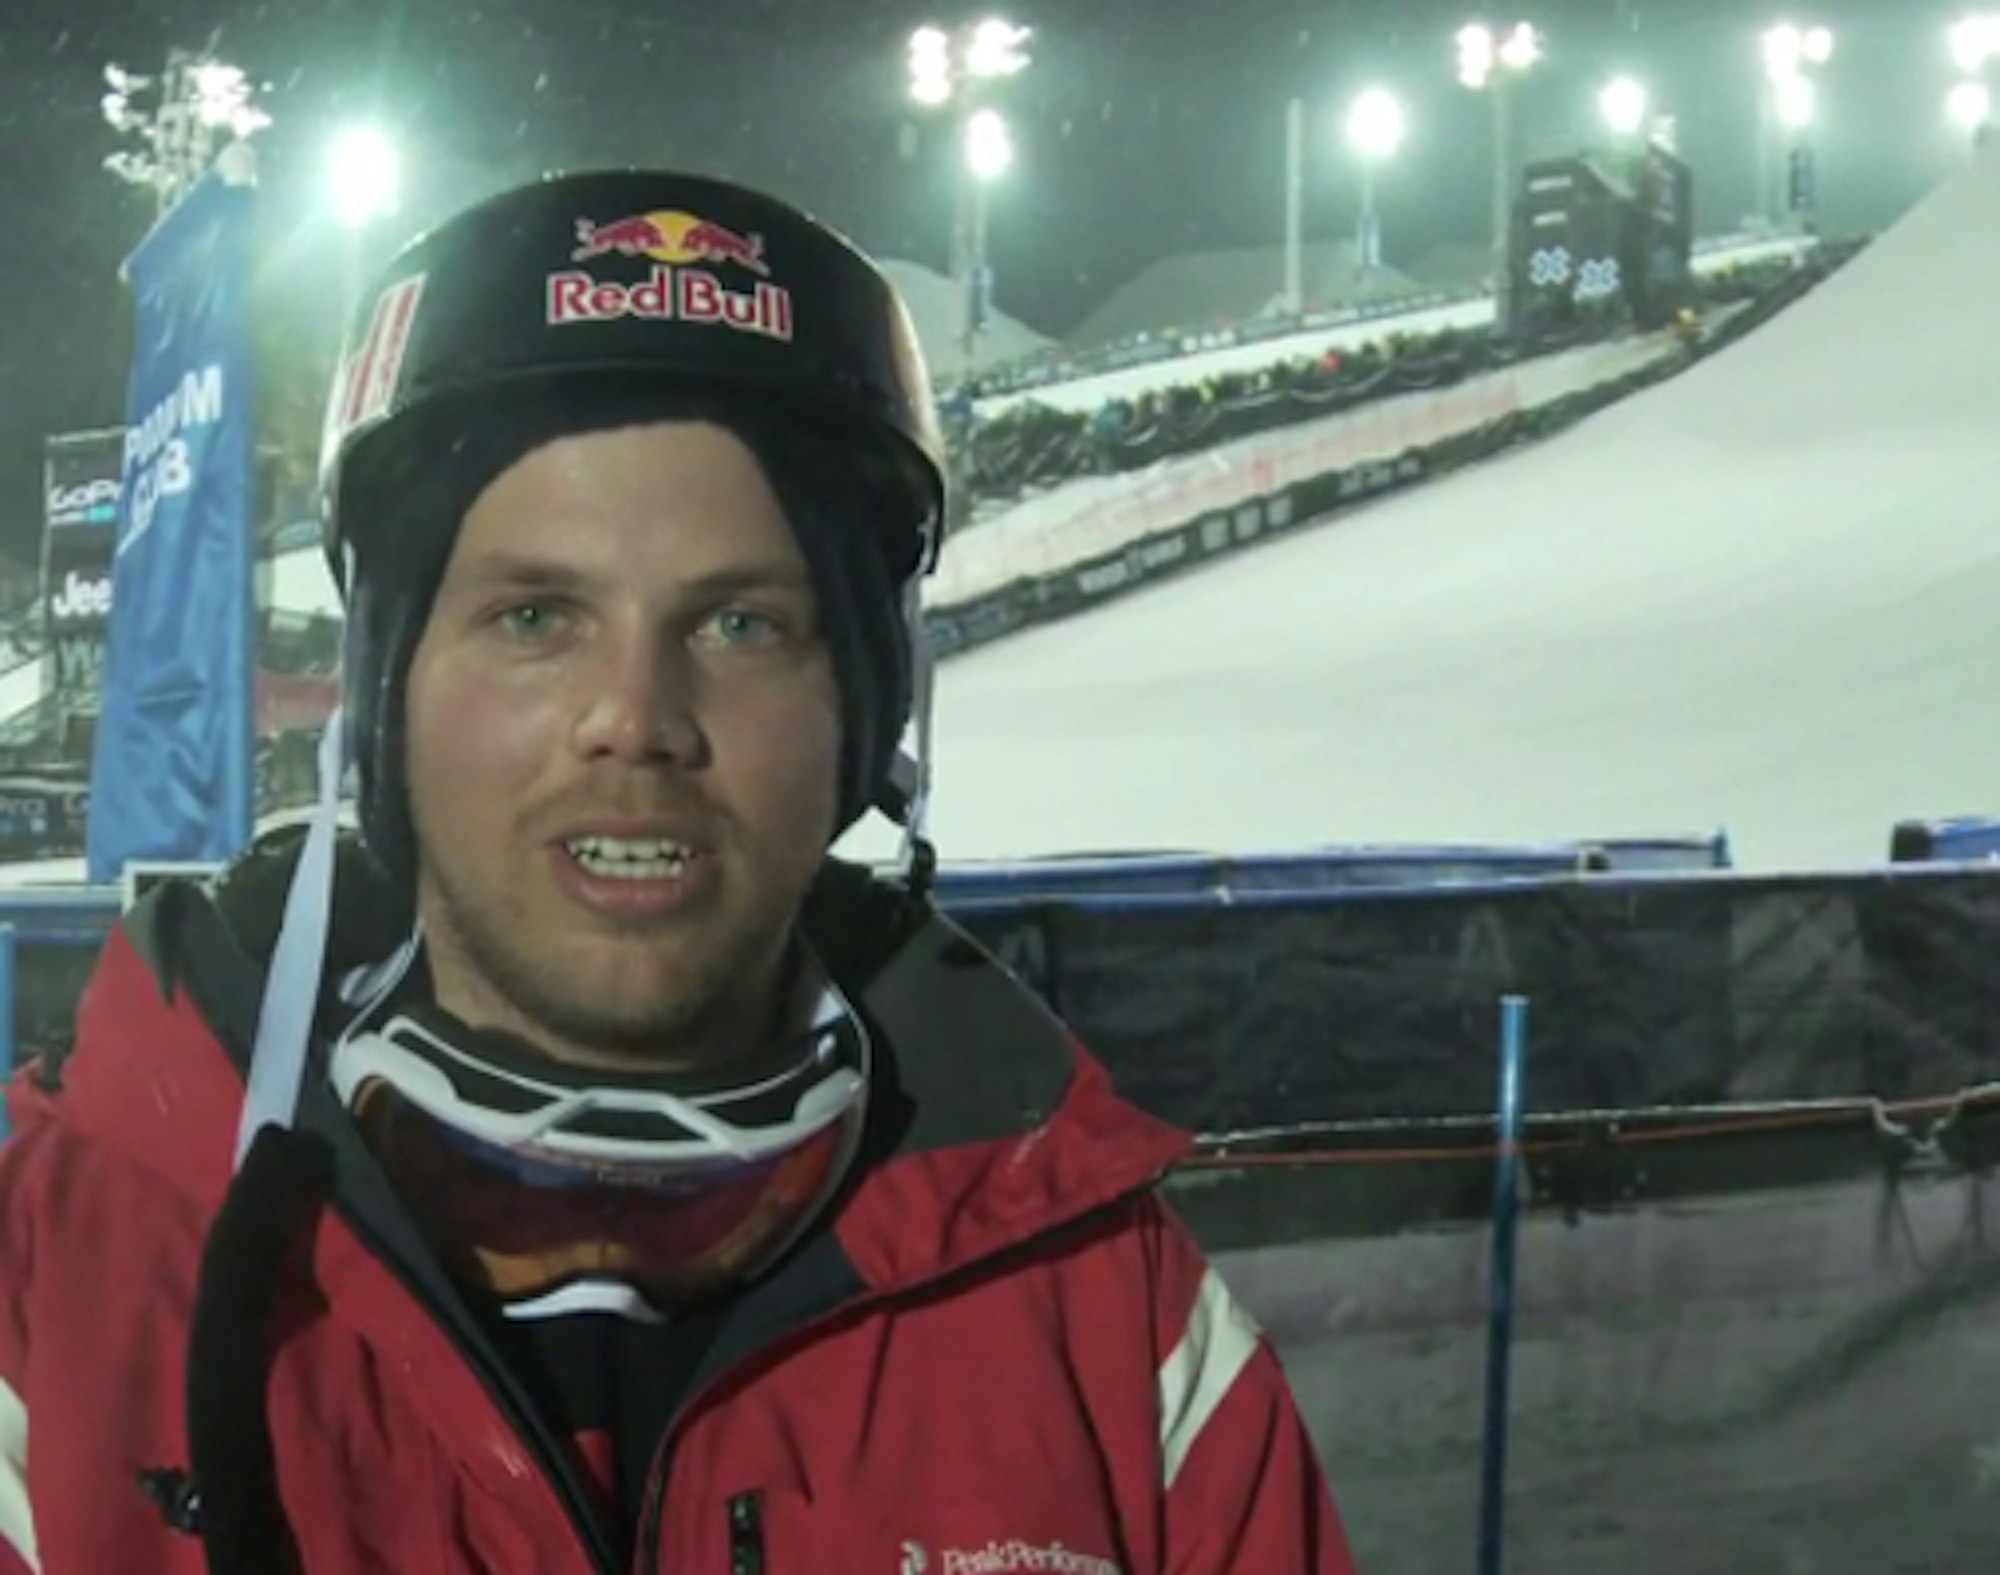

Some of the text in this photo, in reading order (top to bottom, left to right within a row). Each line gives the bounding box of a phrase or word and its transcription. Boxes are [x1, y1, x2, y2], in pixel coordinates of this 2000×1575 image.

[547, 265, 793, 342] Red Bull
[52, 571, 113, 617] Jee
